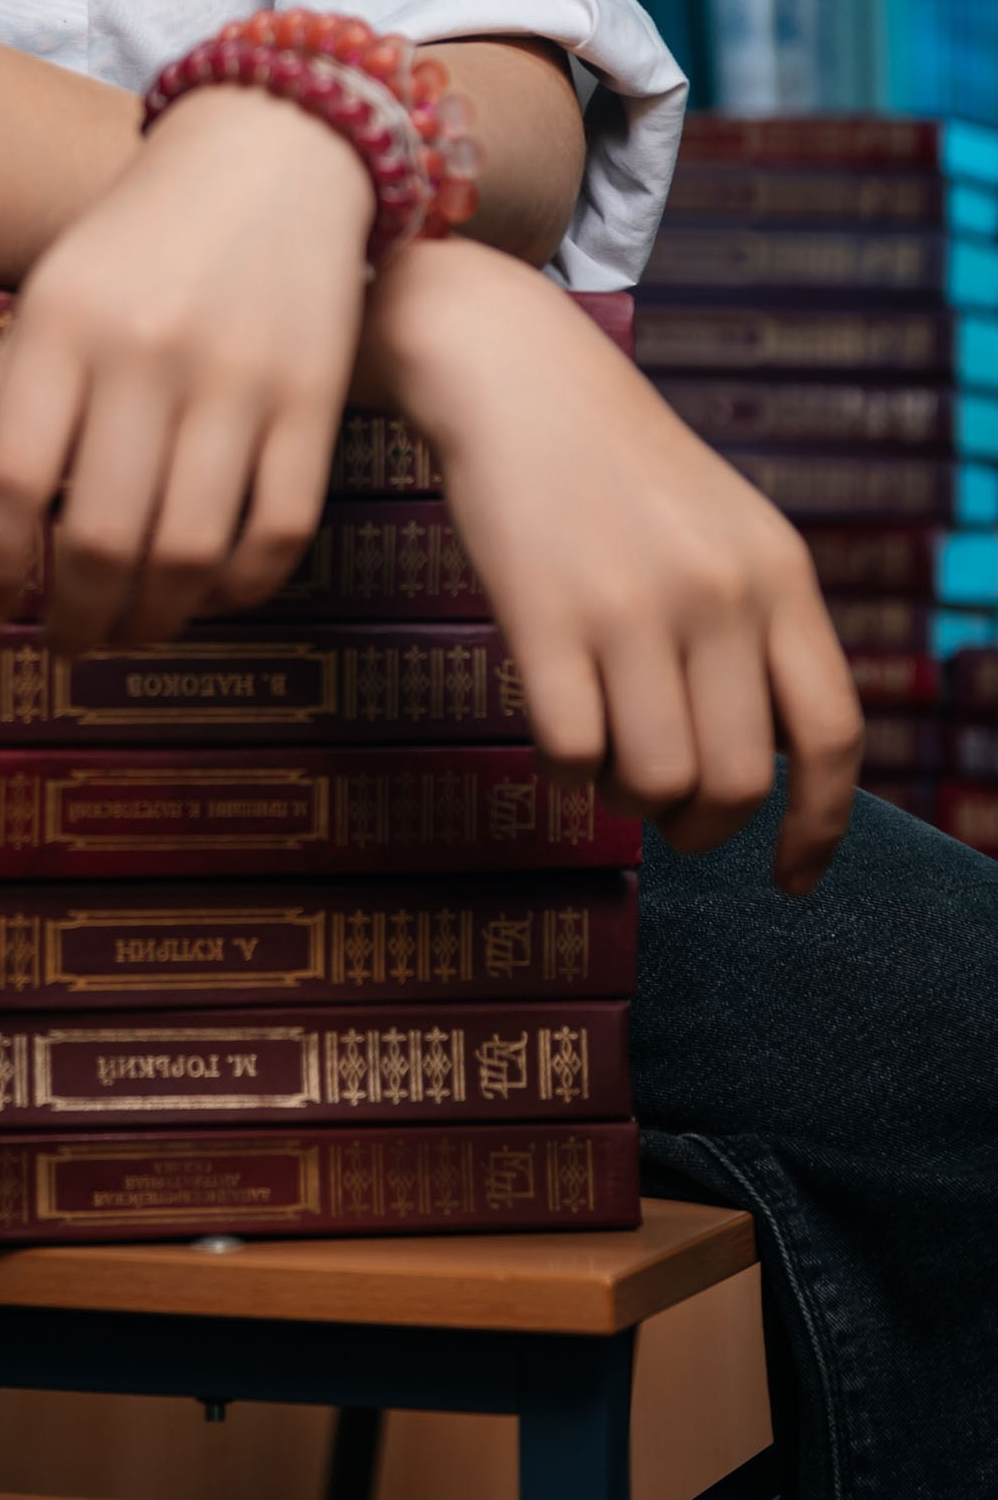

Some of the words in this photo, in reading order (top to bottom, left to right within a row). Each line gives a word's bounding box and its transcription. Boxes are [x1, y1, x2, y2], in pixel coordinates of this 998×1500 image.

[126, 672, 255, 698] НАБОКОВ
[114, 937, 224, 963] КУПРИН
[231, 937, 259, 961] А.
[97, 1054, 220, 1087] ГОРЬКИЙ
[226, 1053, 258, 1077] М.
